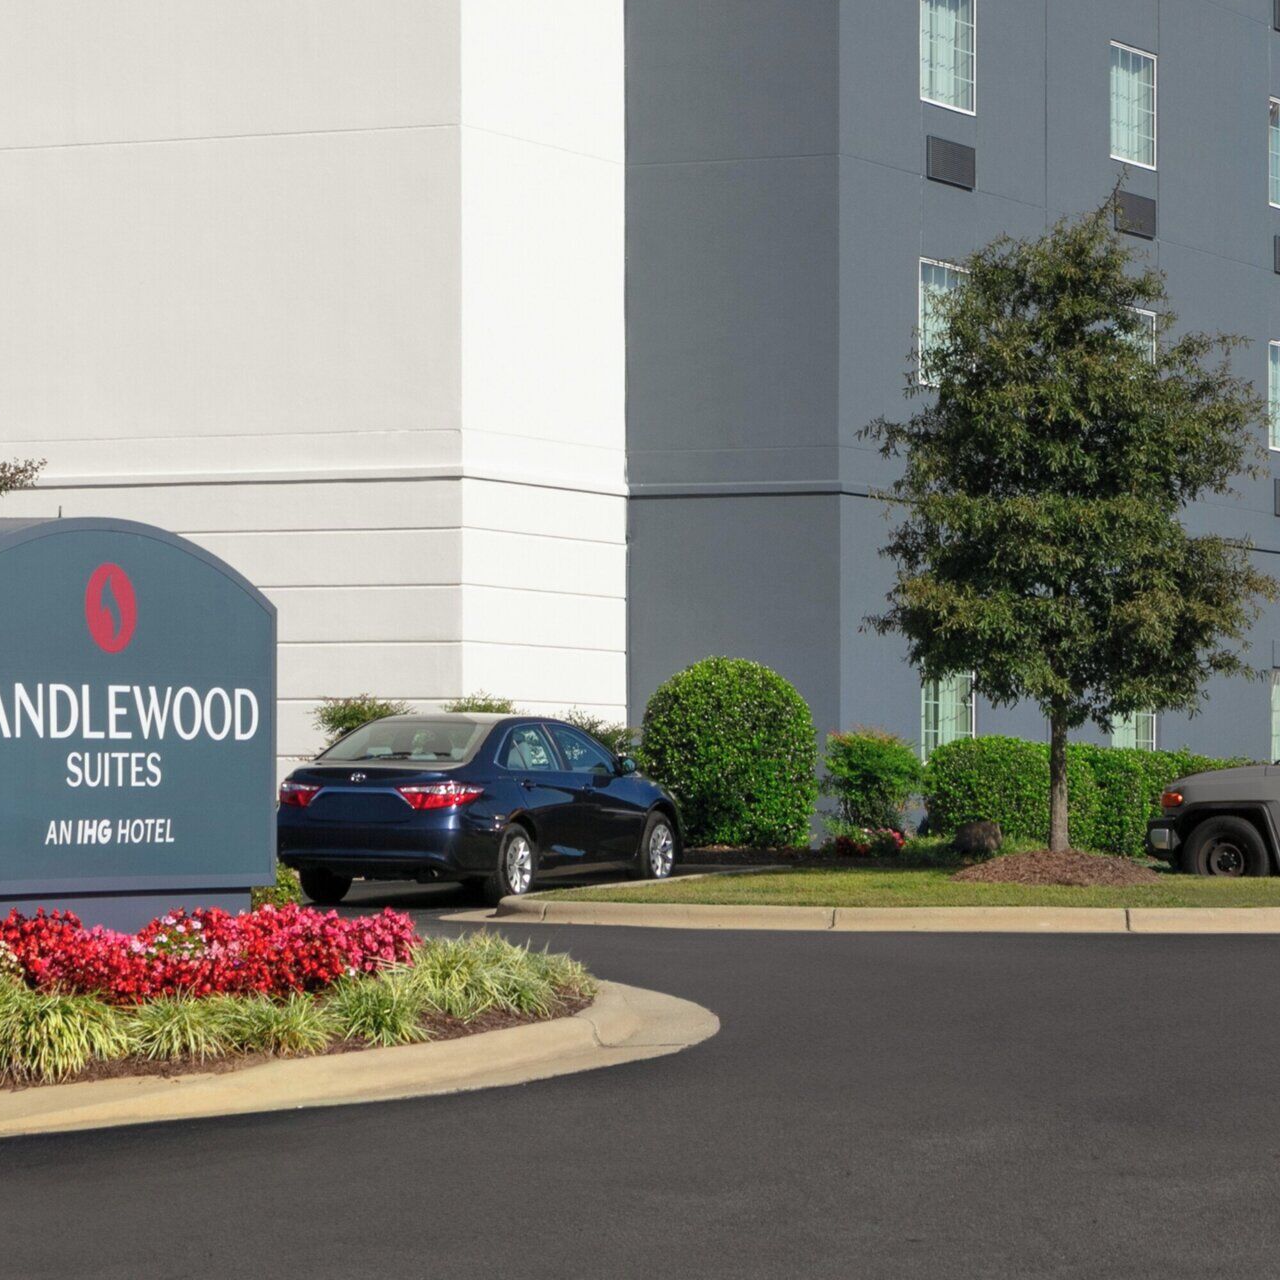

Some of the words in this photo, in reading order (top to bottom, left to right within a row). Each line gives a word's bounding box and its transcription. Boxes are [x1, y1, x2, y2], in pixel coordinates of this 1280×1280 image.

[66, 751, 162, 788] SUITES
[44, 820, 73, 846] AN
[76, 819, 113, 845] IHG
[116, 818, 175, 844] HOTEL
